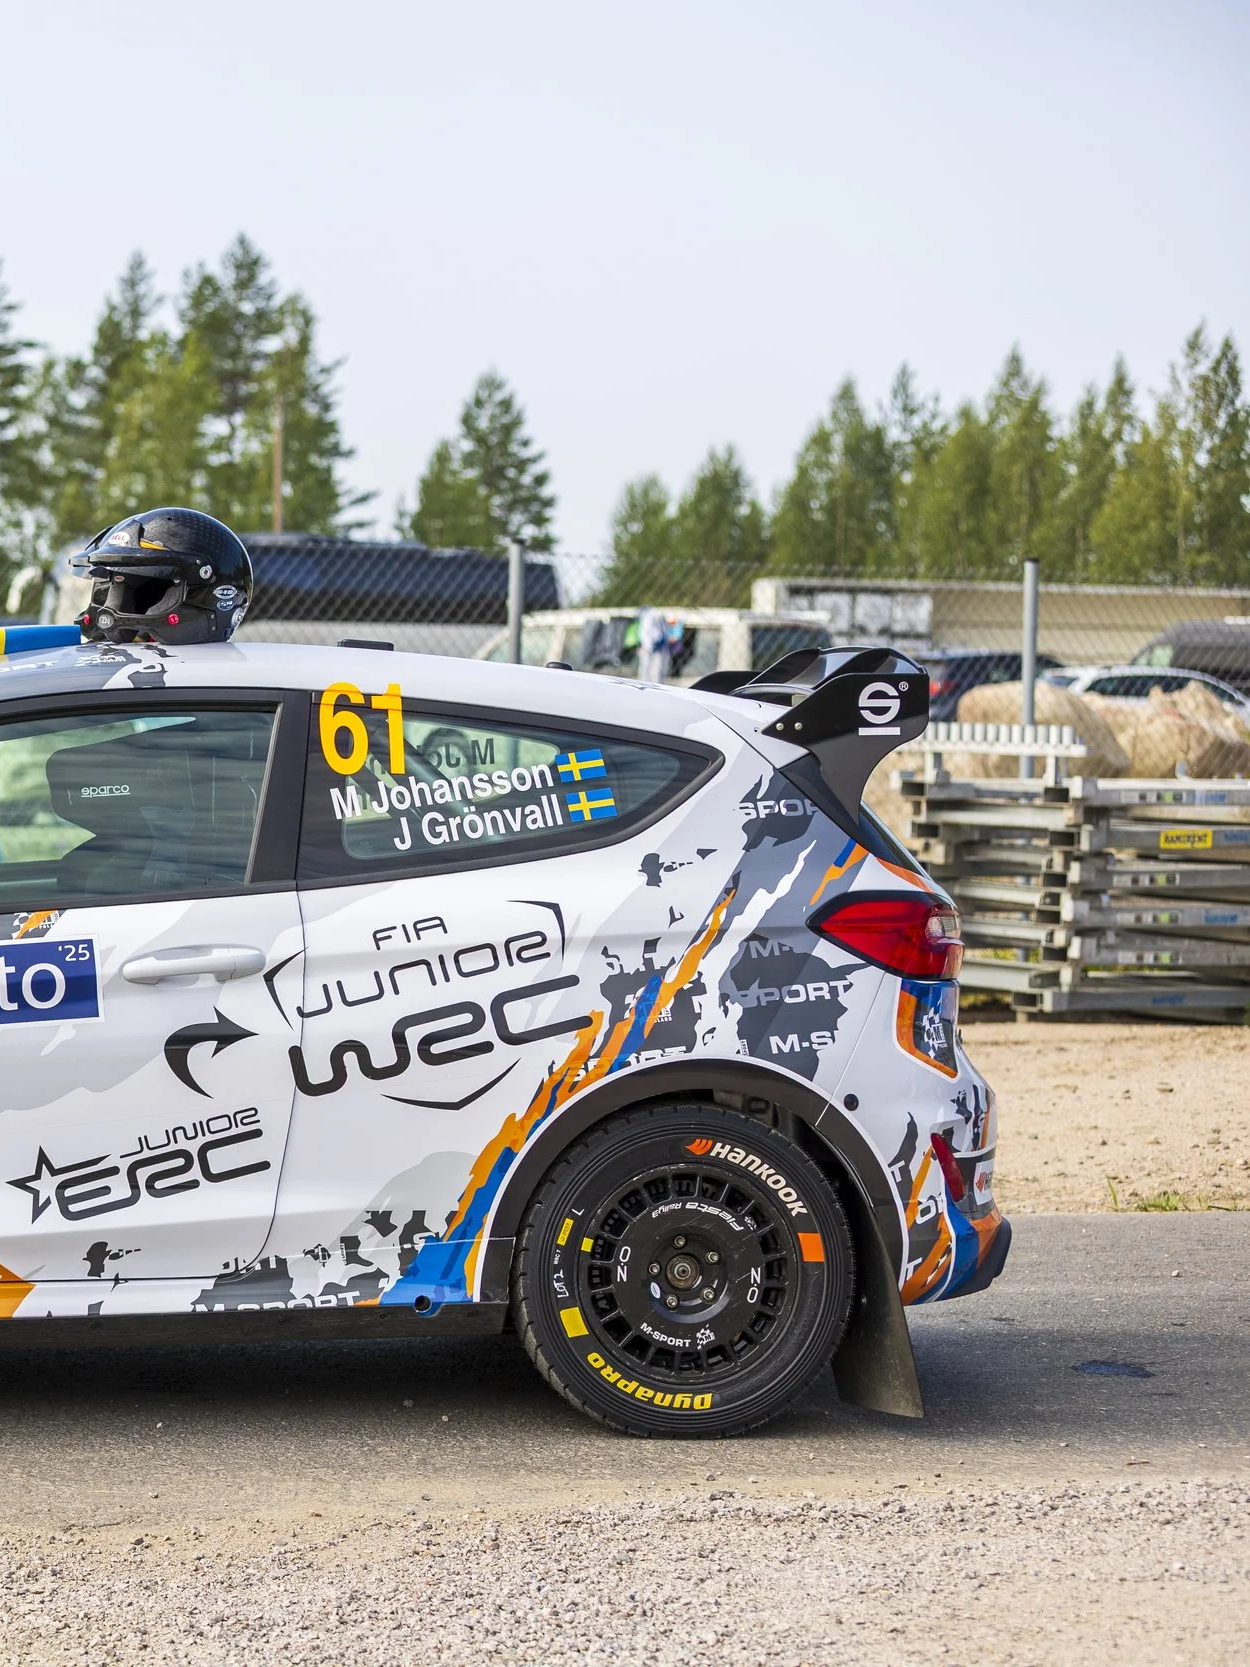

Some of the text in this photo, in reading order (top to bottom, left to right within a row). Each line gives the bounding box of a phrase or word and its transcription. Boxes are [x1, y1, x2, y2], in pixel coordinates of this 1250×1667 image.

[318, 681, 406, 775] 61
[81, 783, 130, 798] sparco
[329, 763, 554, 820] M Johansson
[393, 793, 564, 851] J Grönvall
[372, 916, 448, 950] FIA
[296, 930, 551, 1019] JUNIOR
[288, 974, 593, 1097] WRC
[119, 1106, 261, 1159] JUNIOR
[54, 1128, 271, 1221] ERC
[640, 1322, 691, 1348] M-SPORT
